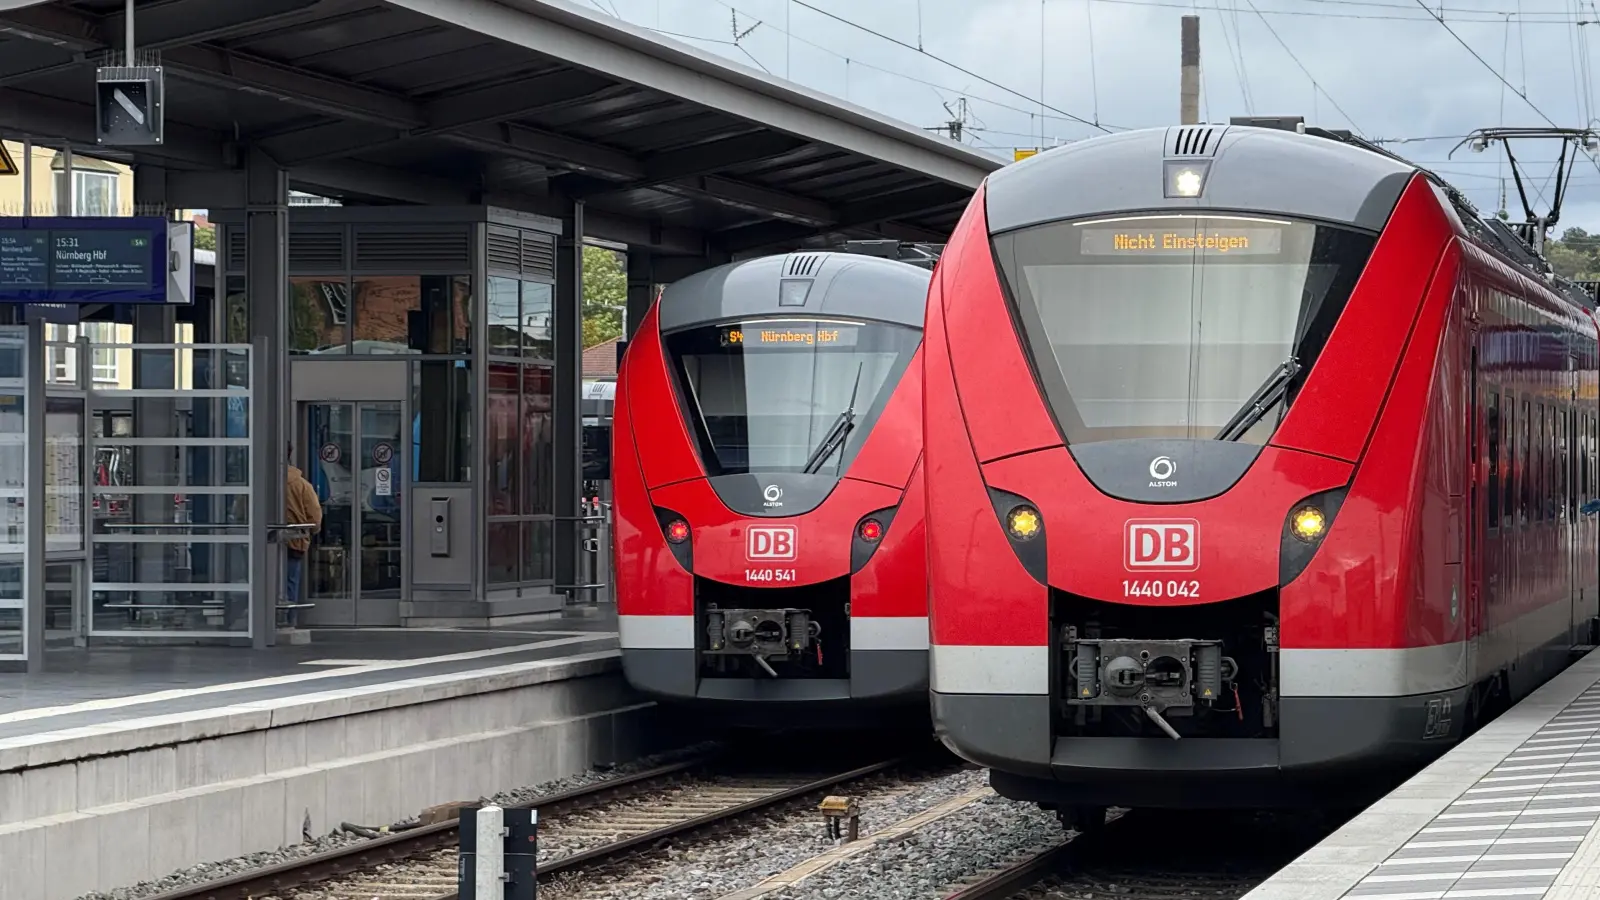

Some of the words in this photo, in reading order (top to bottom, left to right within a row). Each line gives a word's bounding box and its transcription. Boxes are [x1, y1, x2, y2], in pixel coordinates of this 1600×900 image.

[56, 238, 79, 247] 15:31
[135, 239, 143, 247] S4
[1114, 234, 1156, 249] Nicht
[1163, 233, 1249, 252] Einsteigen
[56, 250, 91, 262] Nürnberg
[93, 250, 107, 260] Hbf
[730, 331, 744, 342] S4
[761, 331, 814, 345] Nürnberg
[817, 330, 839, 342] Hbf
[1148, 480, 1178, 488] ALSTOM
[753, 531, 791, 555] DB
[1134, 527, 1191, 563] DB
[745, 568, 772, 581] 1440
[775, 568, 796, 581] 541
[1122, 580, 1163, 597] 1440
[1166, 580, 1200, 597] 042
